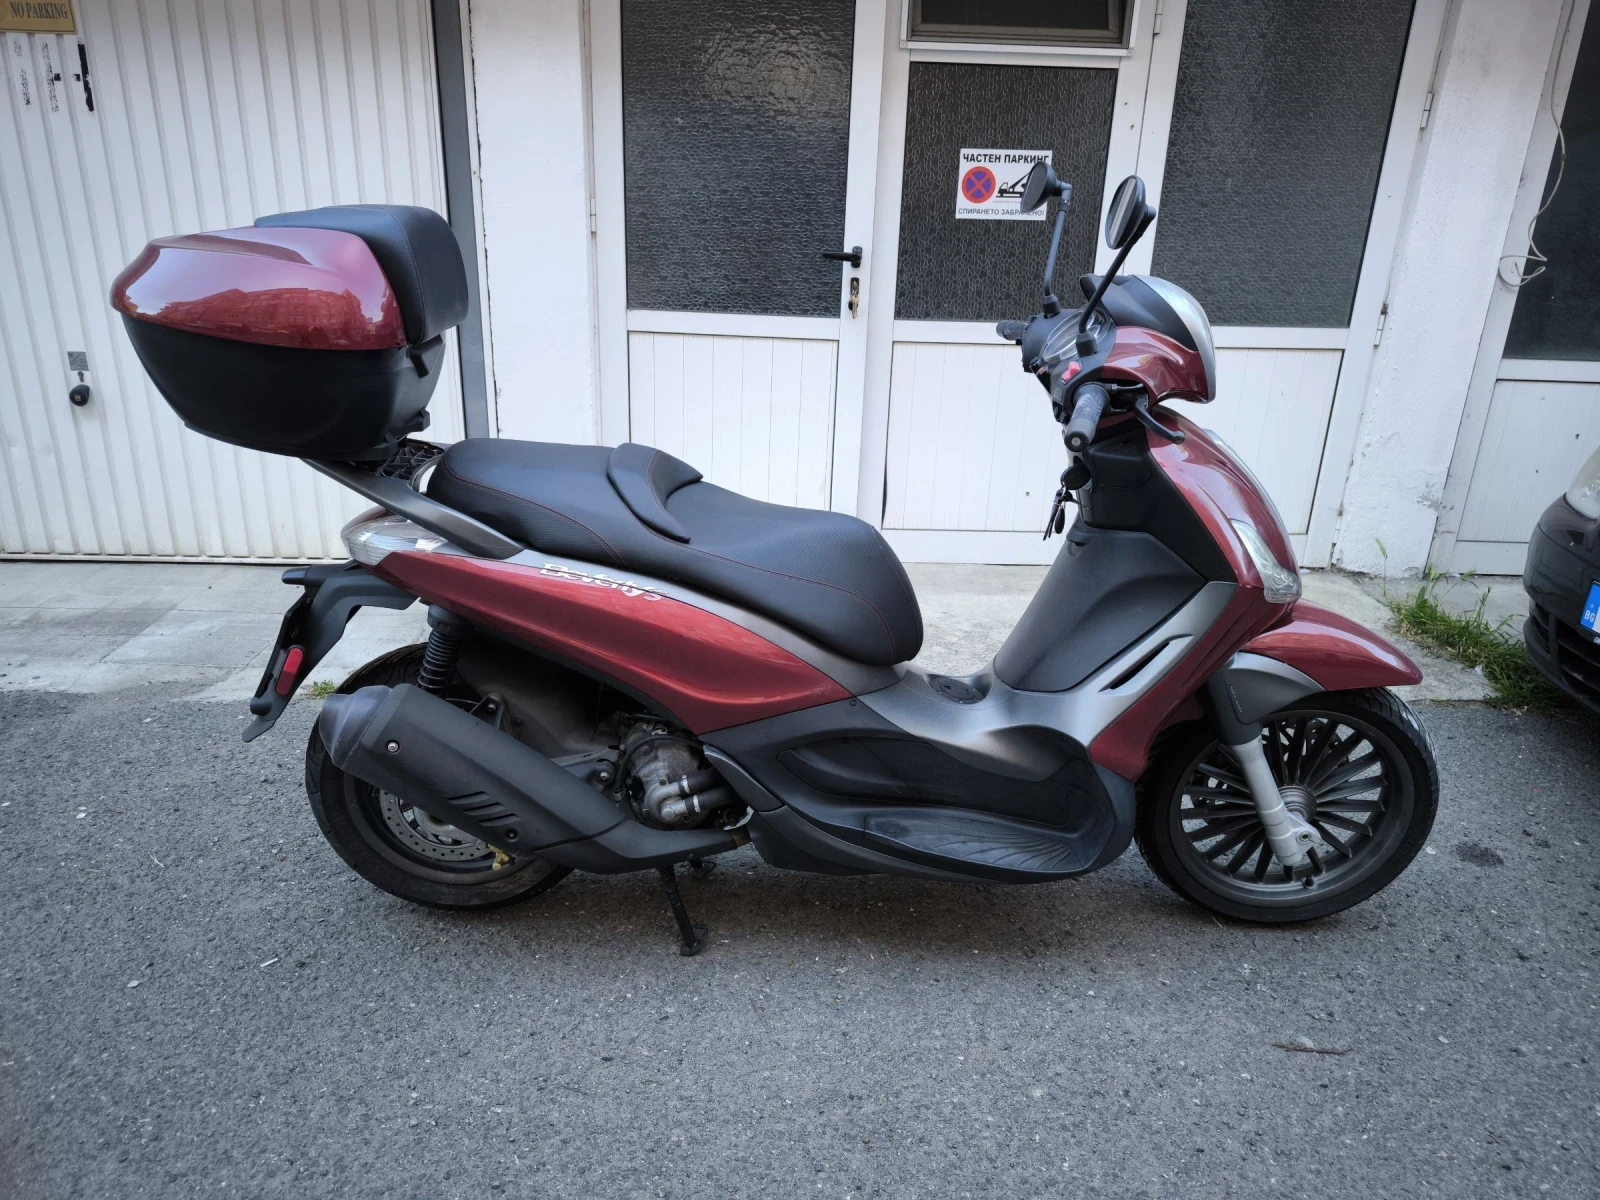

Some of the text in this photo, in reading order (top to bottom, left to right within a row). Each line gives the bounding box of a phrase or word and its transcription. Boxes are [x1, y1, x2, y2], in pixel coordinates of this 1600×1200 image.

[10, 2, 68, 19] NO PARKING
[963, 153, 1002, 163] ЧАСТЕН
[1584, 610, 1596, 623] BG
